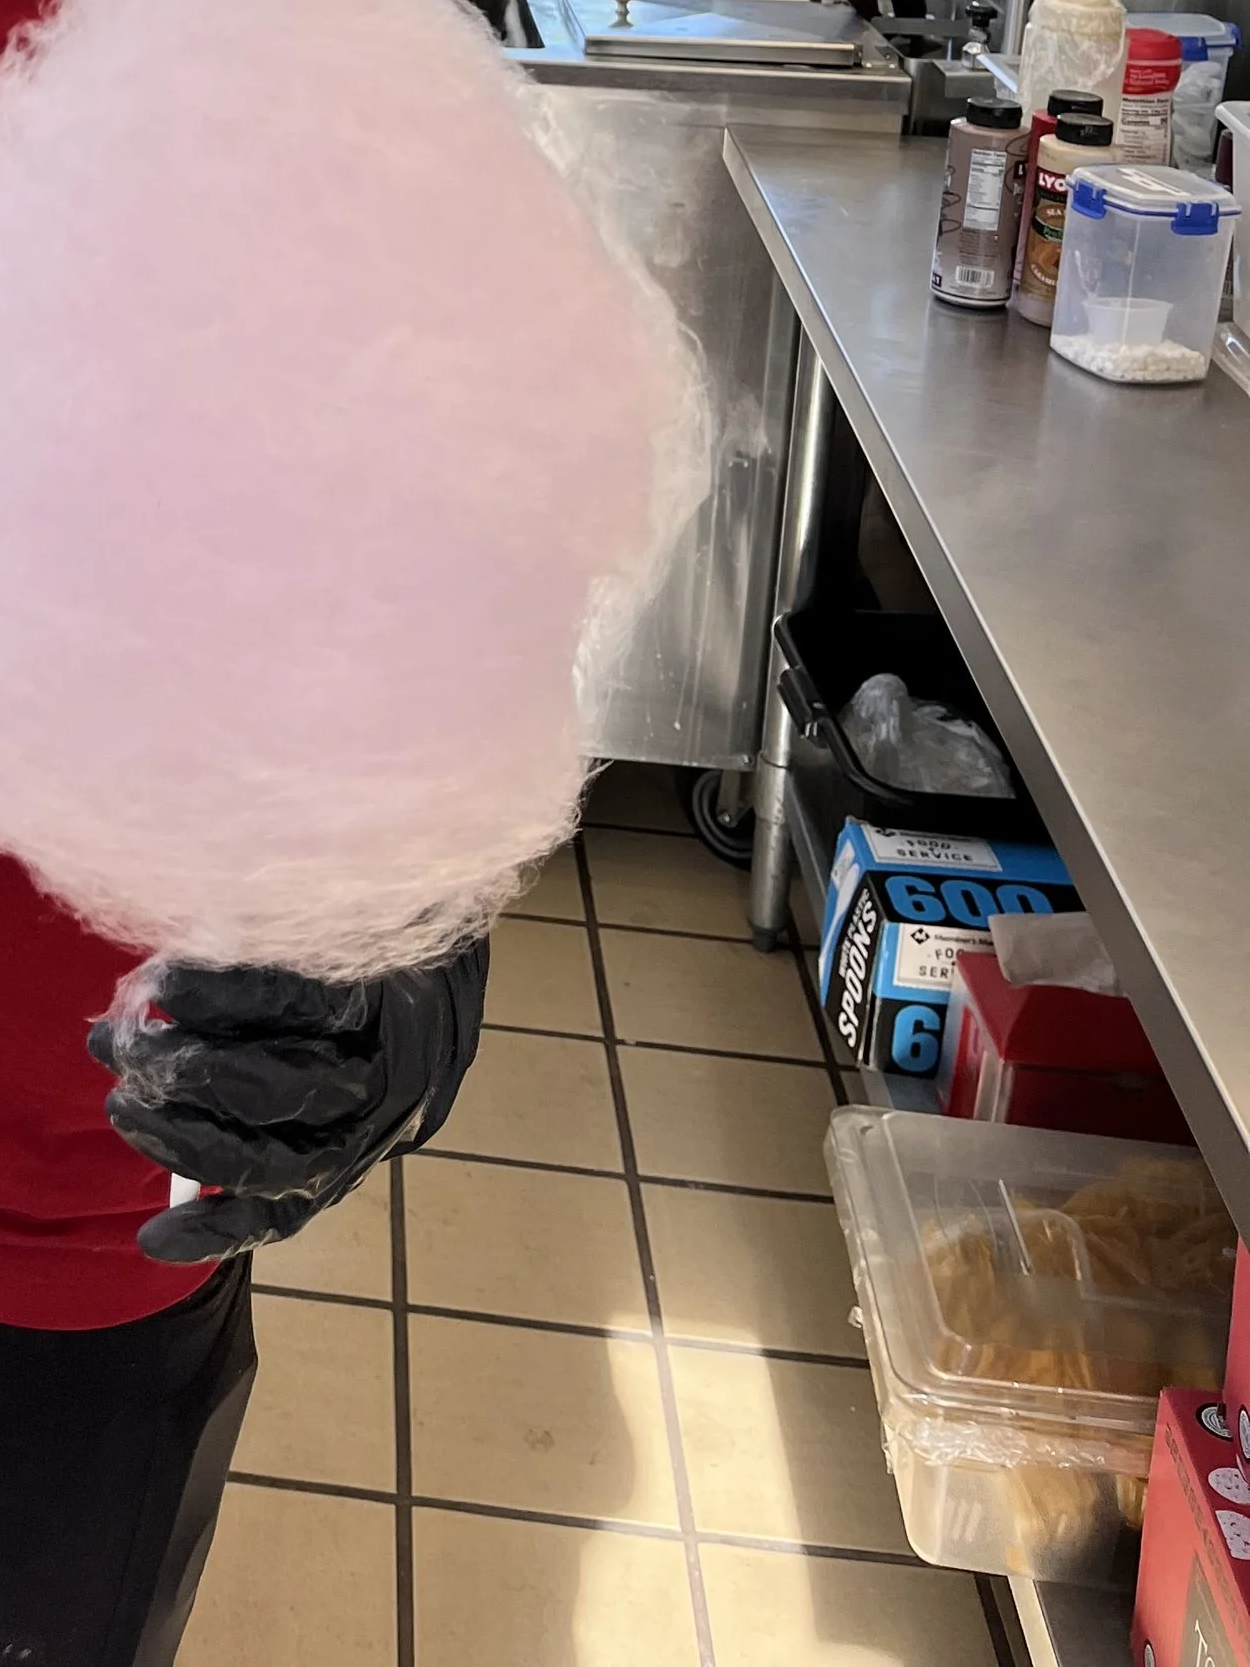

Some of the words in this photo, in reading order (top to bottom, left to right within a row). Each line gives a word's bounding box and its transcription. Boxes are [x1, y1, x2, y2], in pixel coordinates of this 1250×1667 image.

[1038, 172, 1067, 192] LYO
[896, 847, 973, 862] SERVICE
[838, 900, 878, 1049] SPOONS
